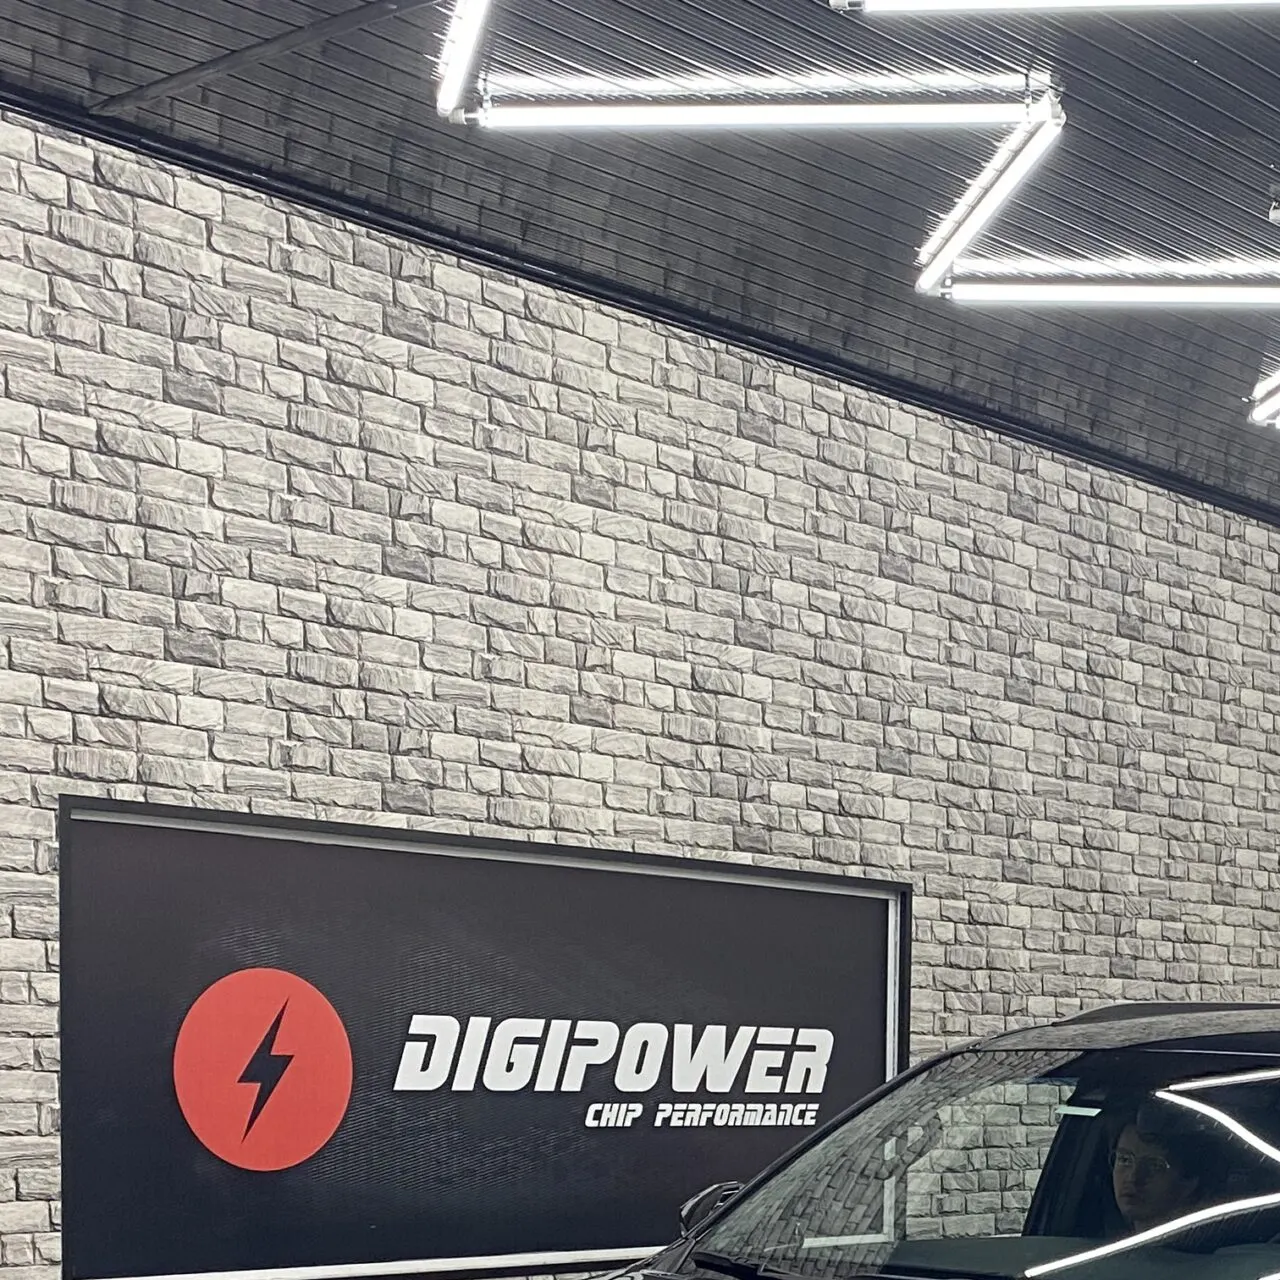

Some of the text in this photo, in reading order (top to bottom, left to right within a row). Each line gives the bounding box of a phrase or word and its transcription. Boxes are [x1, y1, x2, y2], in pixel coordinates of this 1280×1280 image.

[393, 1014, 835, 1094] DIGIPOWER
[584, 1103, 820, 1128] CHIP PERFORMANCE
